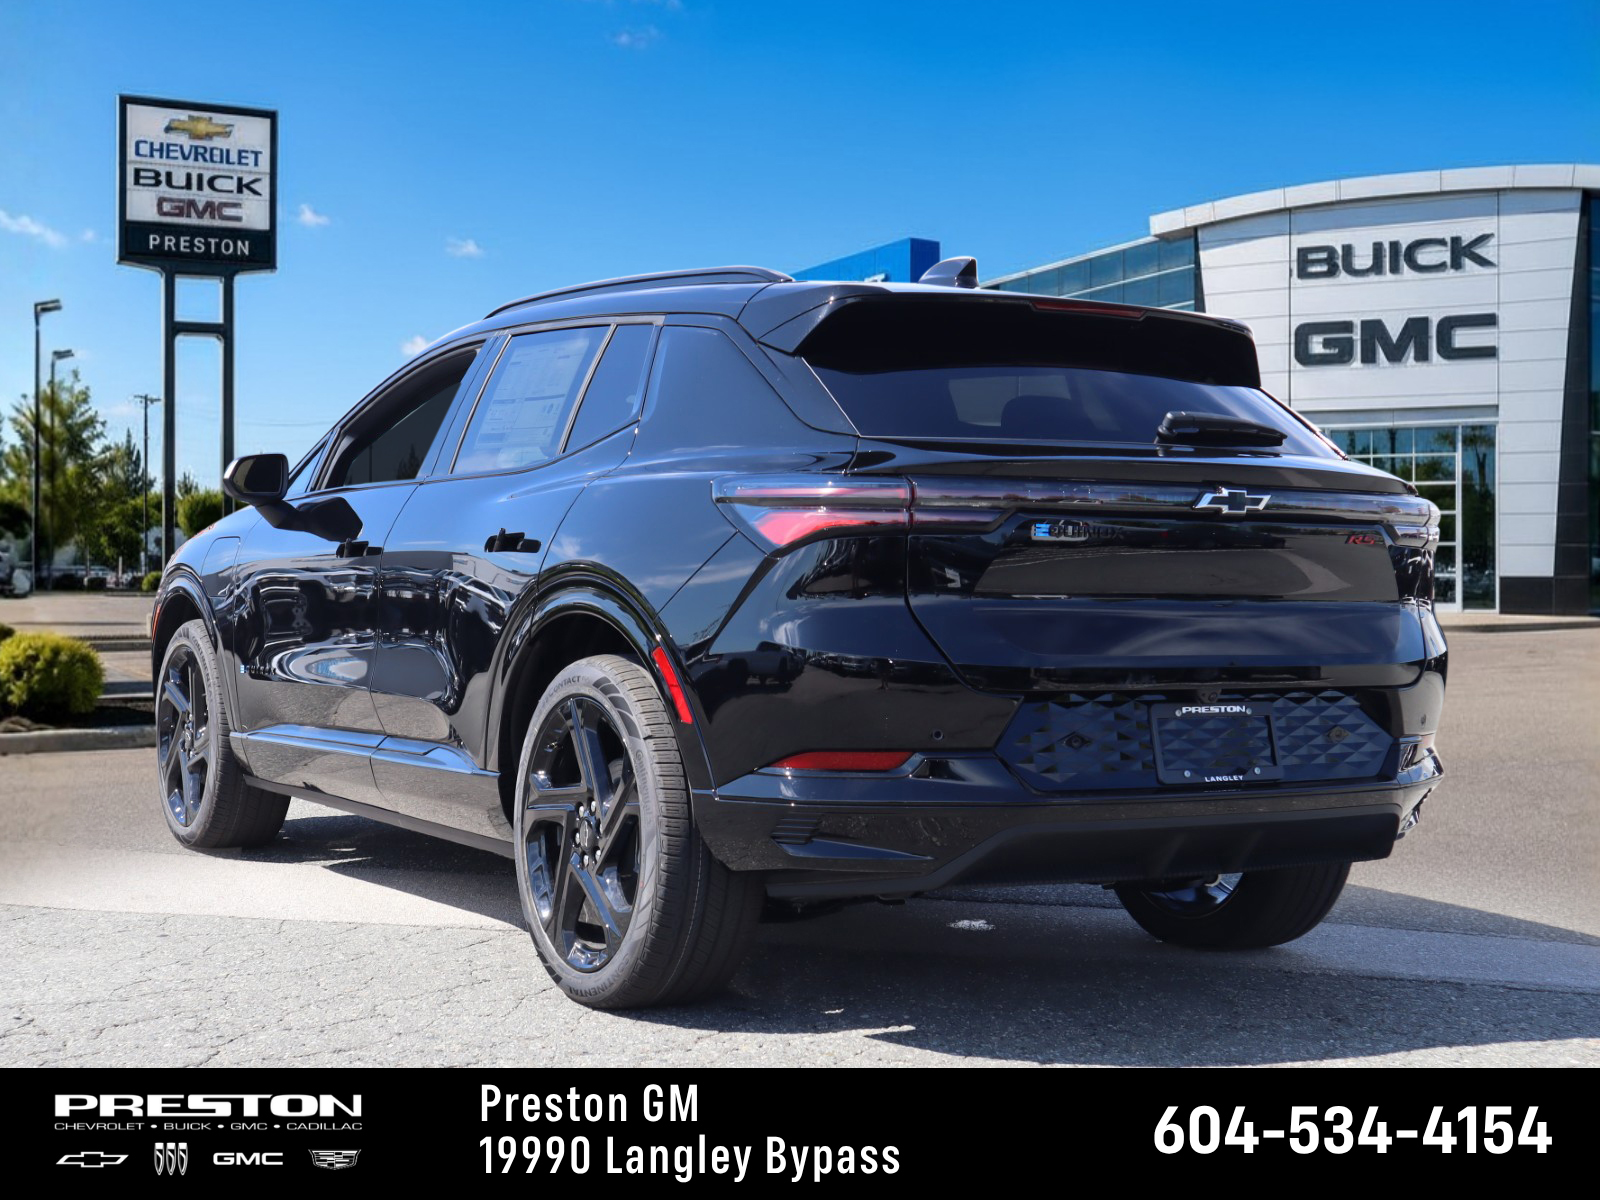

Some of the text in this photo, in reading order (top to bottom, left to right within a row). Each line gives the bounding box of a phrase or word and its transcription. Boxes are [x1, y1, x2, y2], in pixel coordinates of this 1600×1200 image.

[134, 140, 263, 167] CHEVROLET
[133, 167, 262, 196] BUICK
[156, 196, 243, 222] GMC
[148, 234, 249, 256] PRESTON
[1296, 233, 1497, 280] BUICK
[1294, 312, 1498, 367] GMC
[1346, 534, 1376, 545] RS
[1181, 705, 1246, 714] PRESTON
[1204, 775, 1244, 783] LANGLEY
